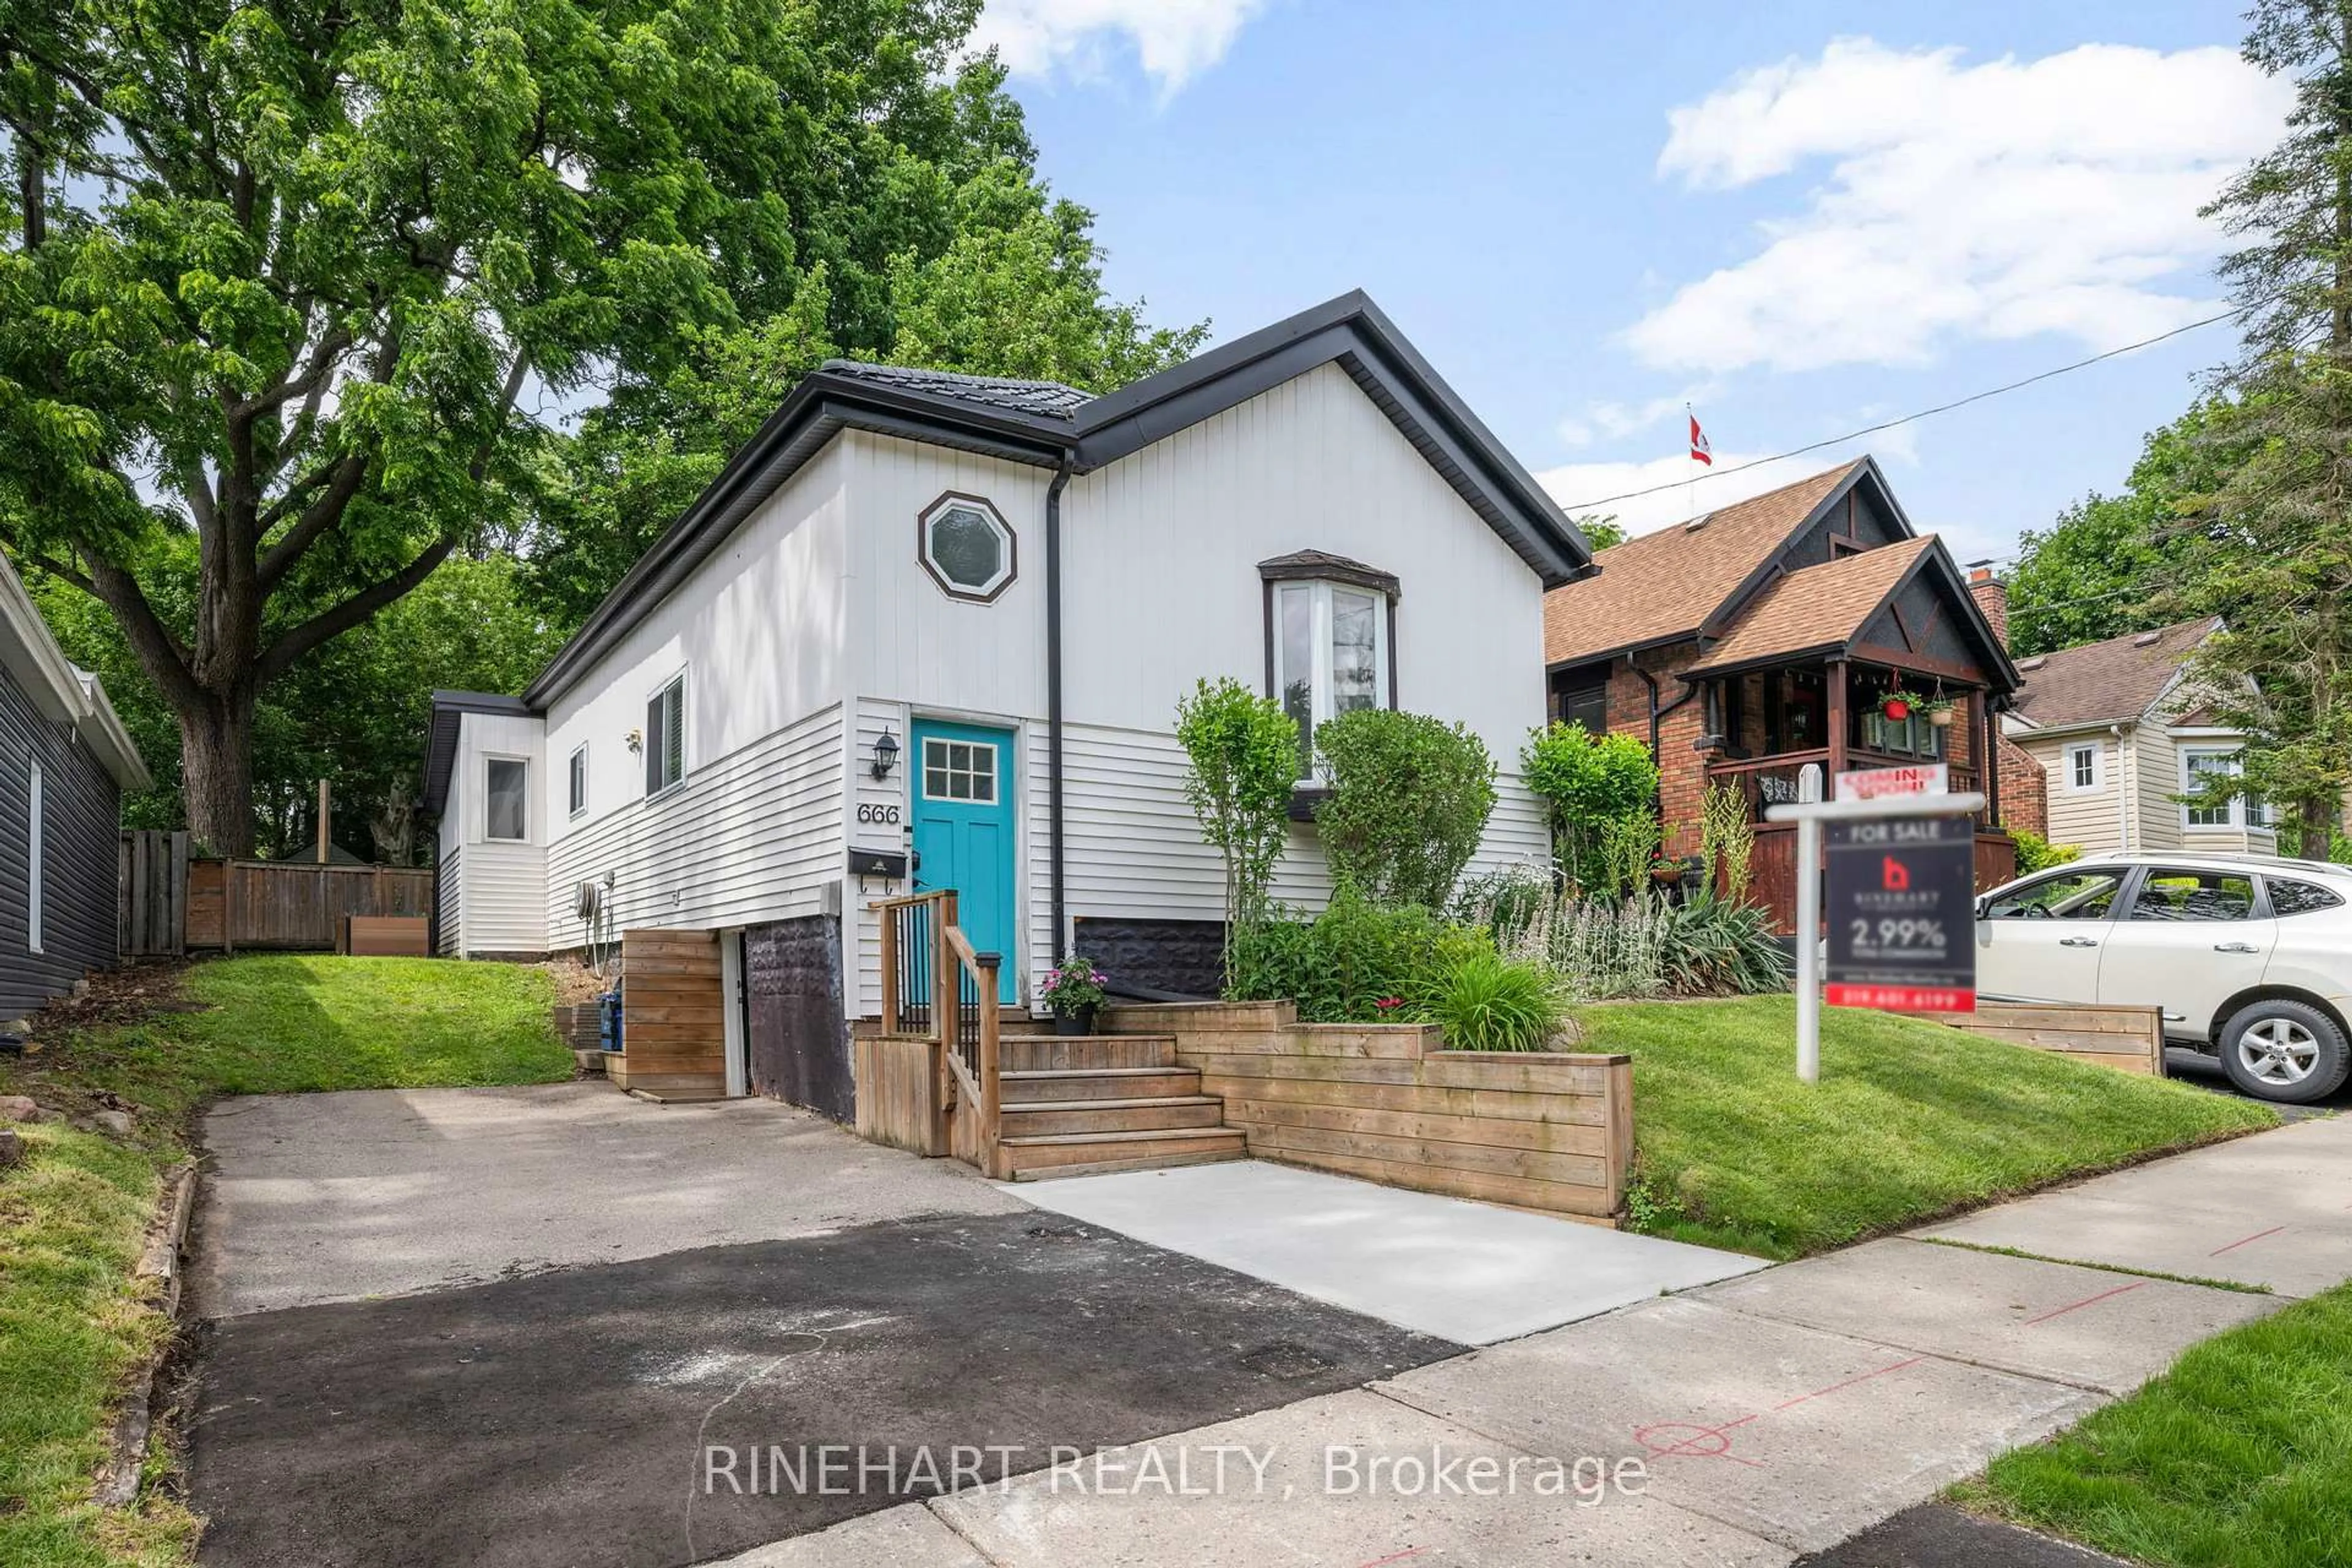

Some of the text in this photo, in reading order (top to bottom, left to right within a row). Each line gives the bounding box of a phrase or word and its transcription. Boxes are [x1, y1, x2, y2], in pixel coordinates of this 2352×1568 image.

[858, 804, 899, 824] 666
[1850, 820, 1940, 843] FOR SALE
[1850, 918, 1947, 946] 2.99%
